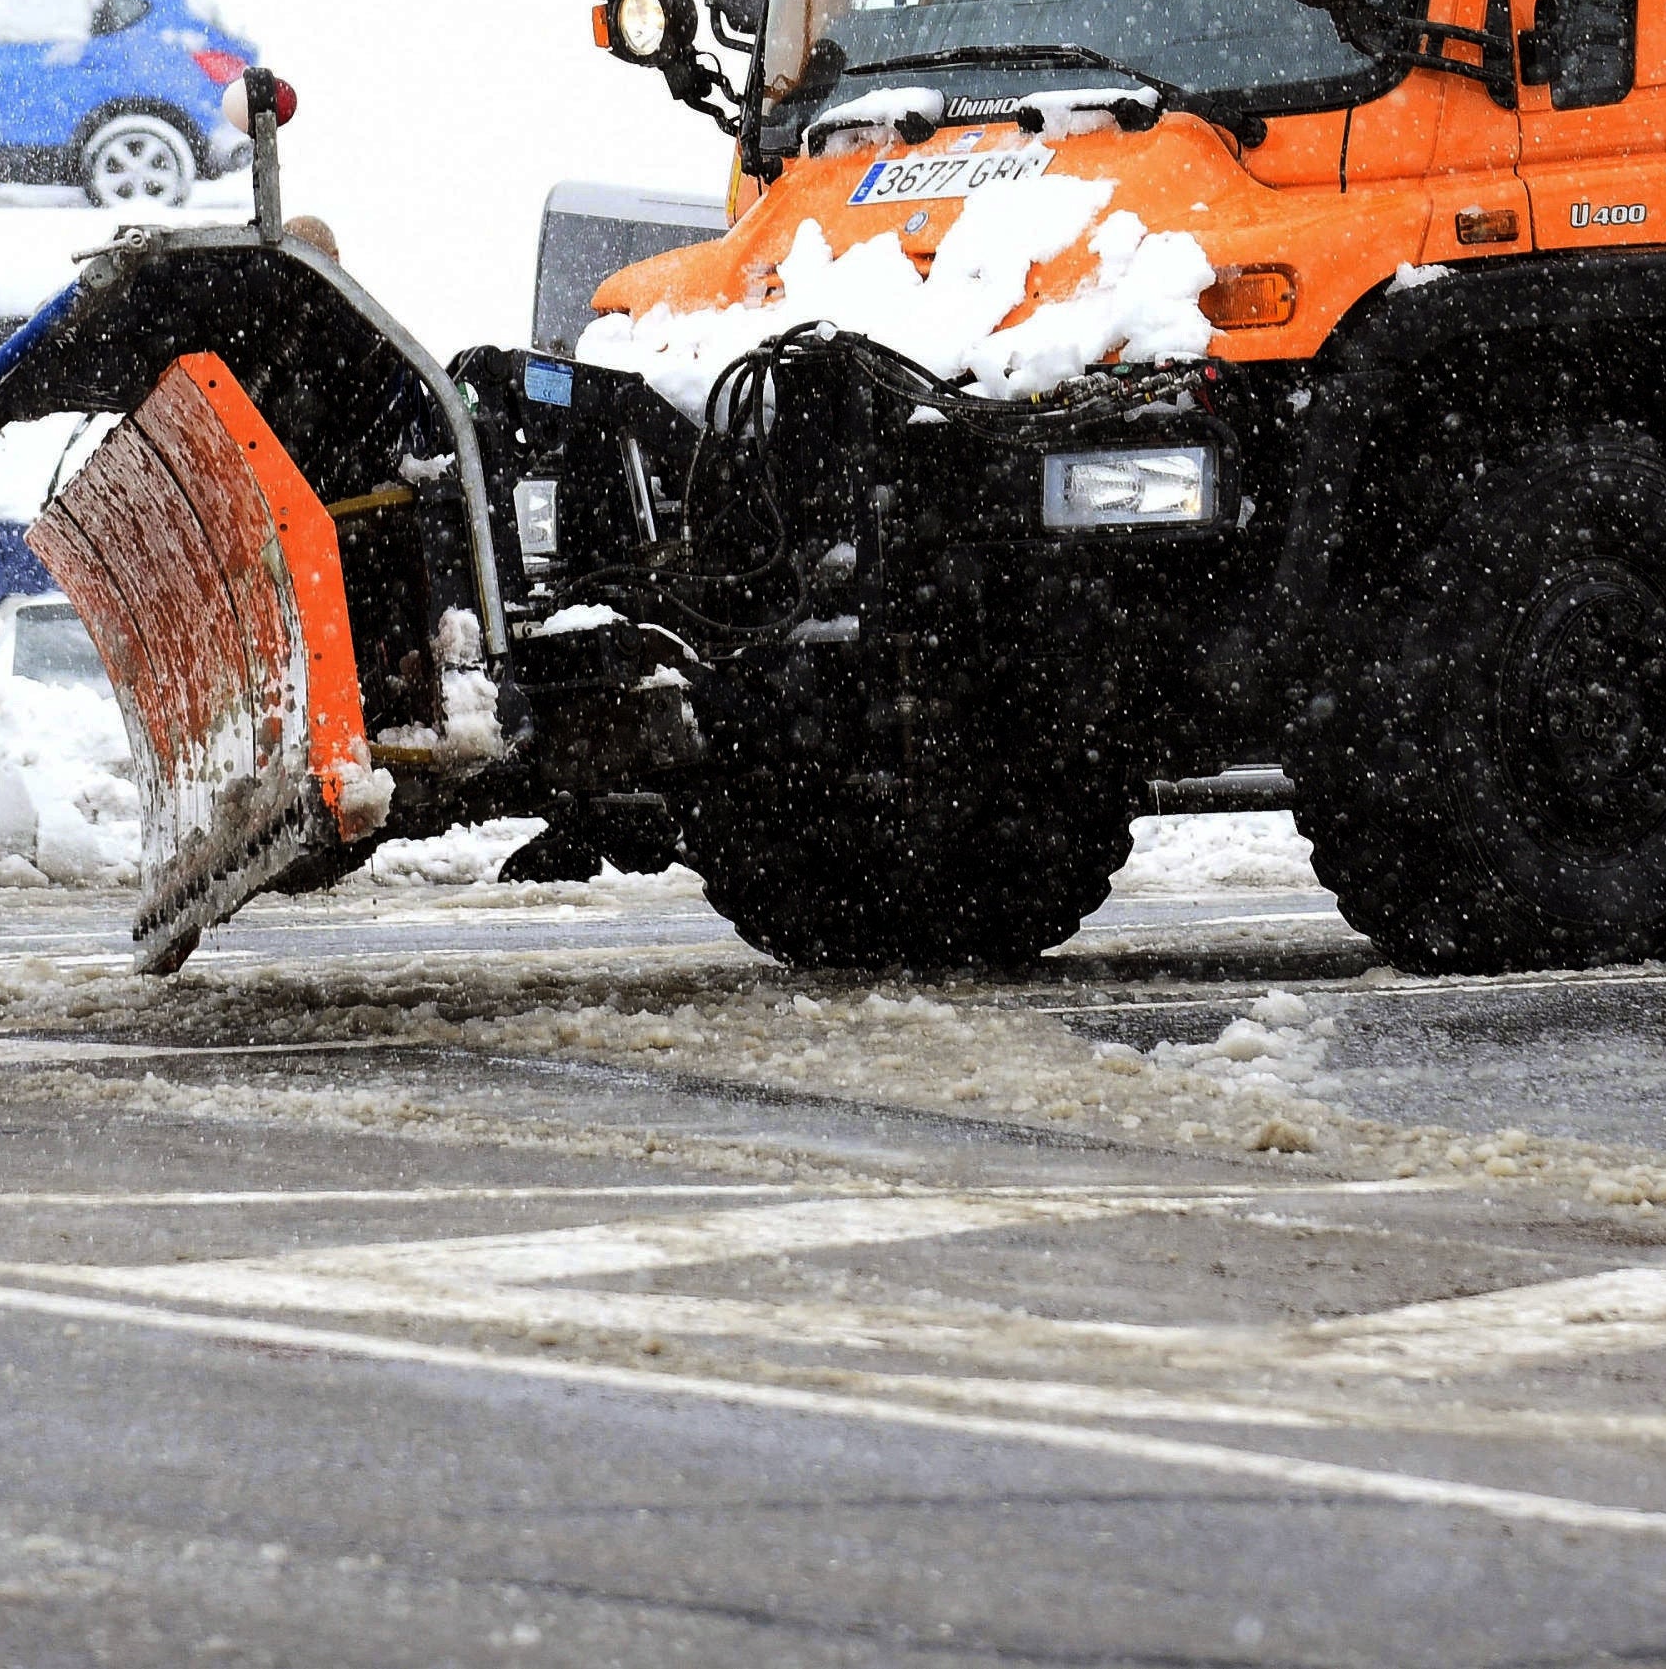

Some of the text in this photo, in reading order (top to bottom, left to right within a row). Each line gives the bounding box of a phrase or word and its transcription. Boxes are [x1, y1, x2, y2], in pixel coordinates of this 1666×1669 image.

[946, 96, 1020, 118] UNIMO
[876, 159, 969, 196] 3677
[1571, 203, 1647, 228] U 400
